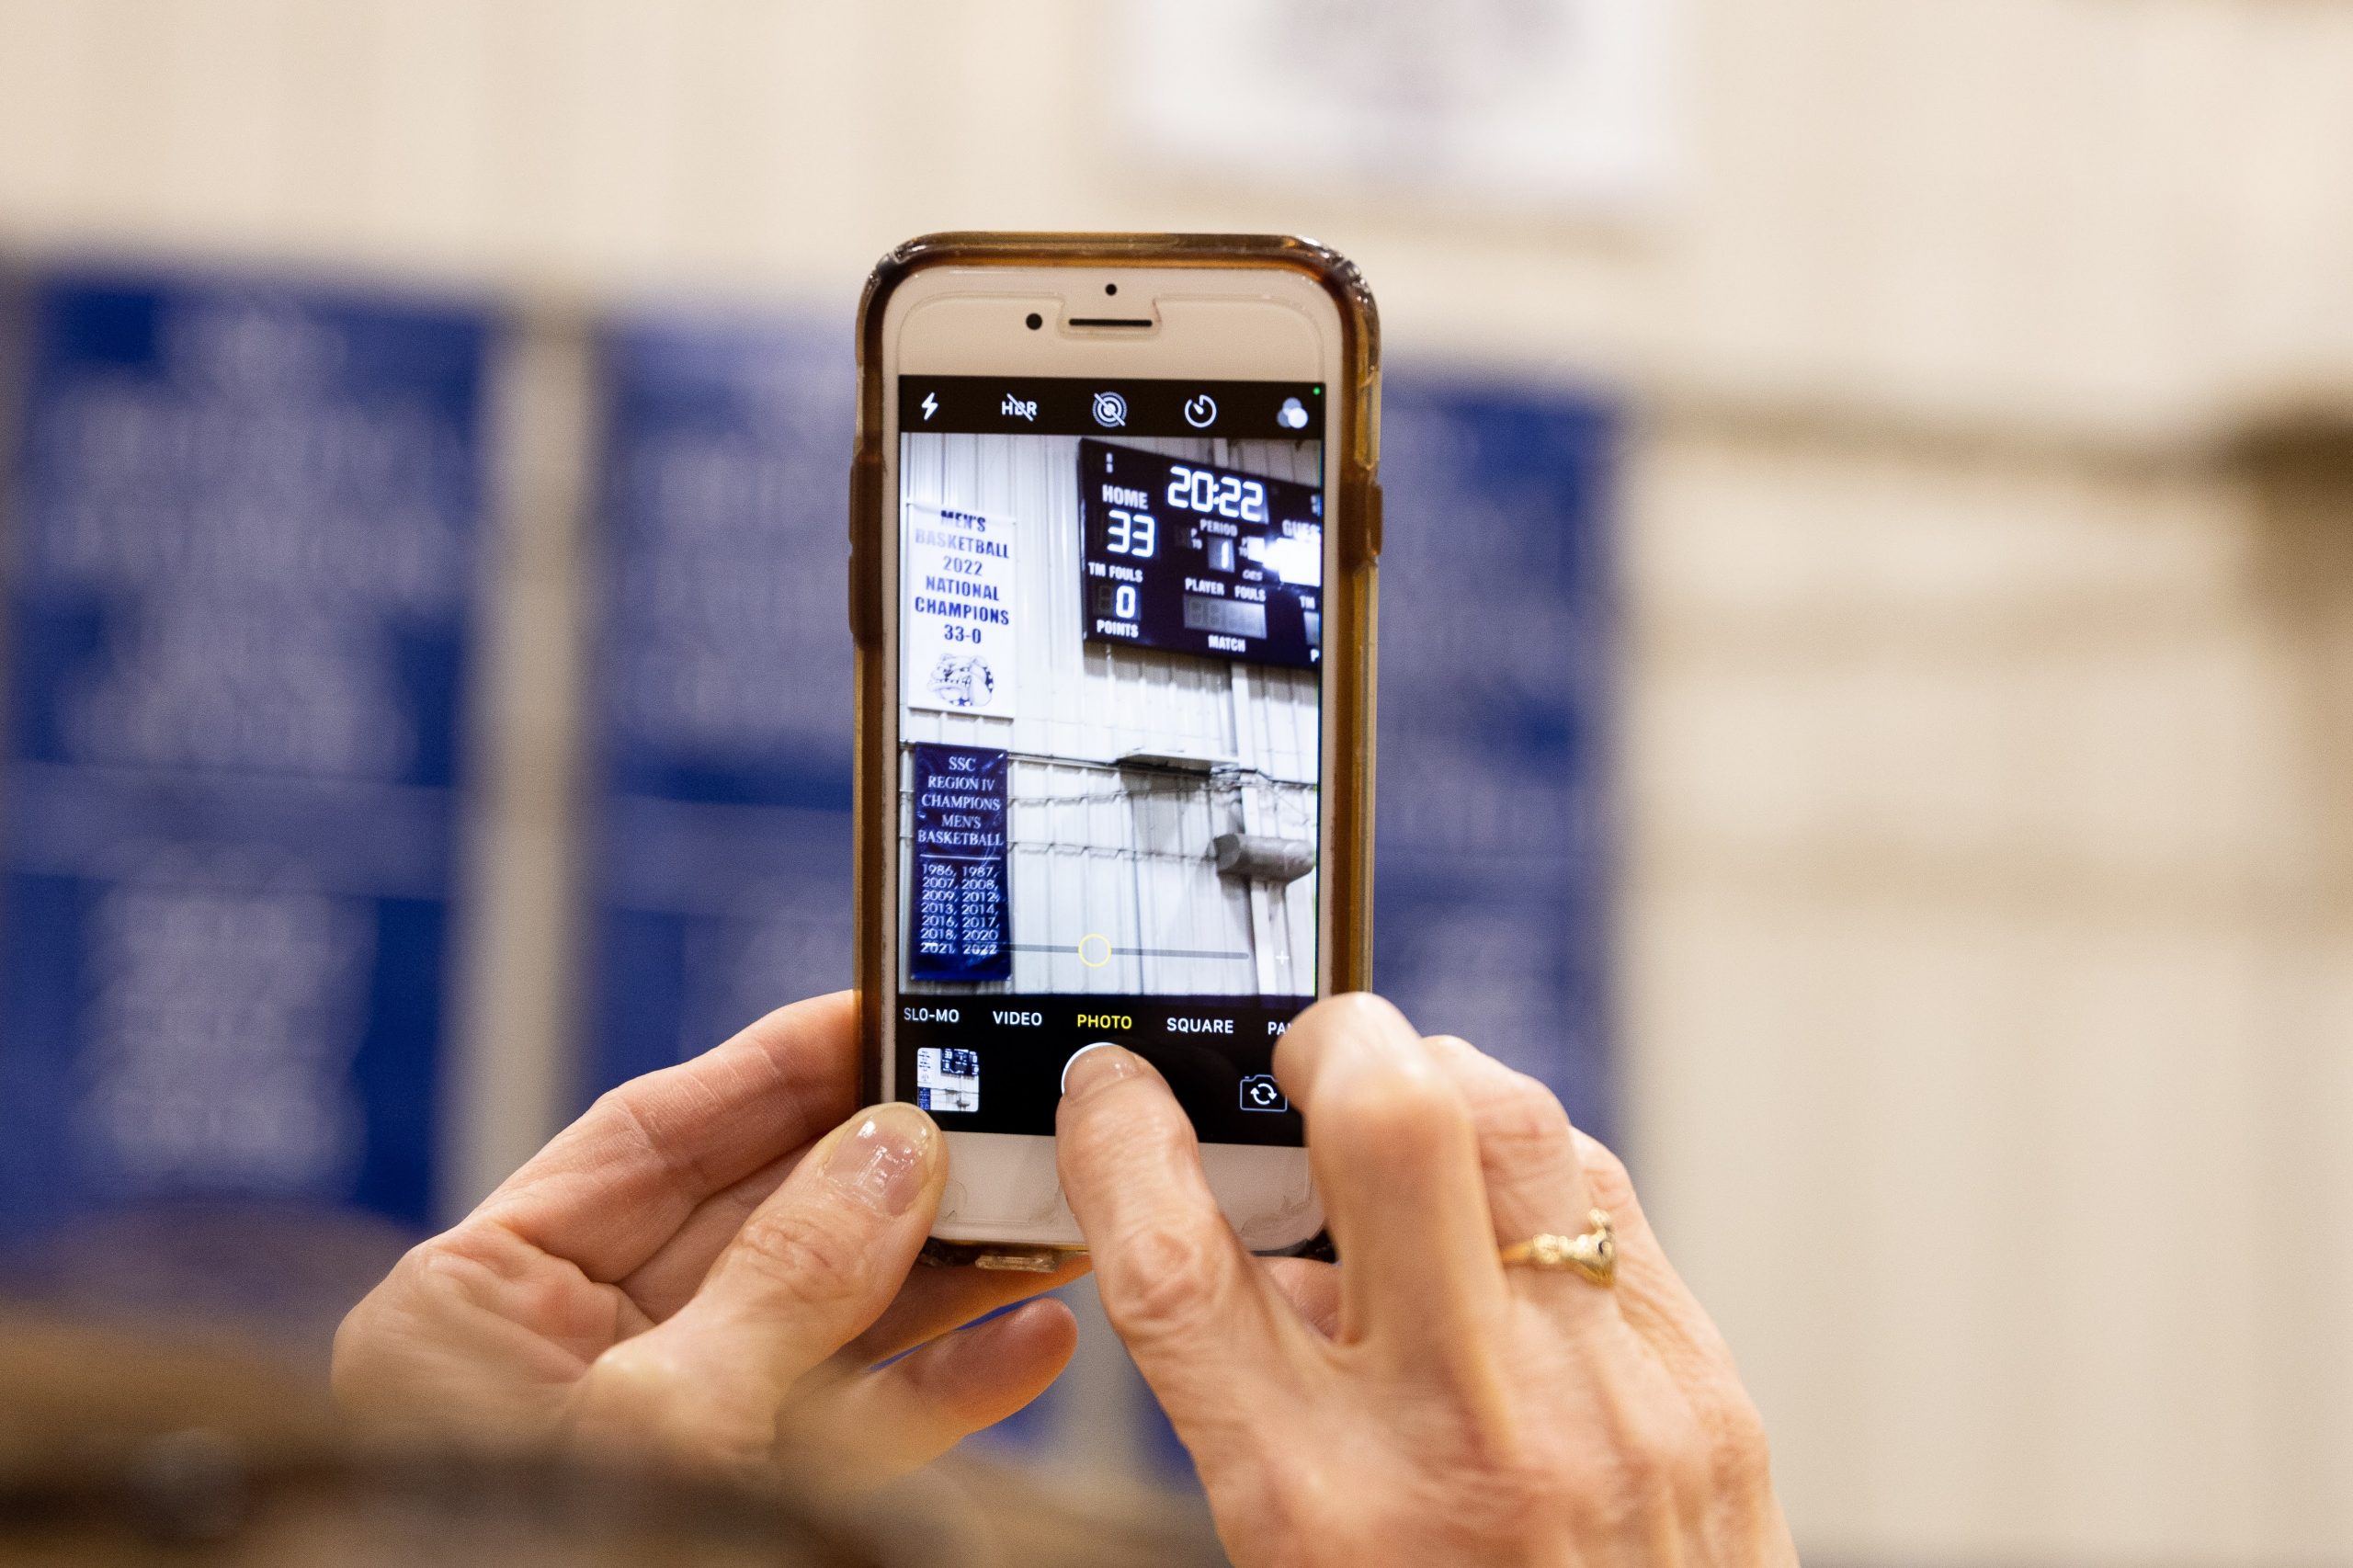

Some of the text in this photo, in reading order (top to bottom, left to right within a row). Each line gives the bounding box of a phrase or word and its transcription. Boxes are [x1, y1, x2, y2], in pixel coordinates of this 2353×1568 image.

[1002, 401, 1037, 415] HDR
[1102, 483, 1148, 509] HOME
[1167, 465, 1264, 522] 20:22
[940, 509, 986, 533] MEN'S
[1199, 518, 1238, 538] PERIOD
[1108, 509, 1155, 558] 33
[915, 527, 1010, 559] BASKETBALL
[943, 554, 983, 577] 2022
[1088, 561, 1143, 584] TM FOULS
[926, 574, 999, 602] NATIONAL
[1184, 576, 1267, 603] PLAYER FOULS
[1116, 585, 1136, 619] 0
[1299, 595, 1315, 610] TM
[915, 596, 1009, 626] CHAMPIONS
[944, 623, 982, 644] 33-0
[1097, 619, 1139, 639] POINTS
[1208, 634, 1246, 653] MATCH
[949, 756, 976, 771] SSC
[927, 776, 995, 791] REGION IV
[921, 793, 1001, 811] CHAMPIONS
[941, 814, 981, 829] MEN'S
[917, 829, 1004, 846] BASKETBALL
[922, 864, 1000, 878] 1986, 1987,
[922, 877, 998, 892] 2007, 2008,
[922, 890, 959, 903] 2009,
[921, 902, 999, 915] 2013, 2014,
[921, 915, 1000, 928] 2016, 2017,
[920, 927, 957, 940] 2018,
[962, 944, 998, 956] 2022
[904, 1007, 960, 1024] SLO-MO
[993, 1010, 1042, 1027] VIDEO
[1076, 1014, 1132, 1030] PHOTO
[1166, 1017, 1233, 1034] SQUARE
